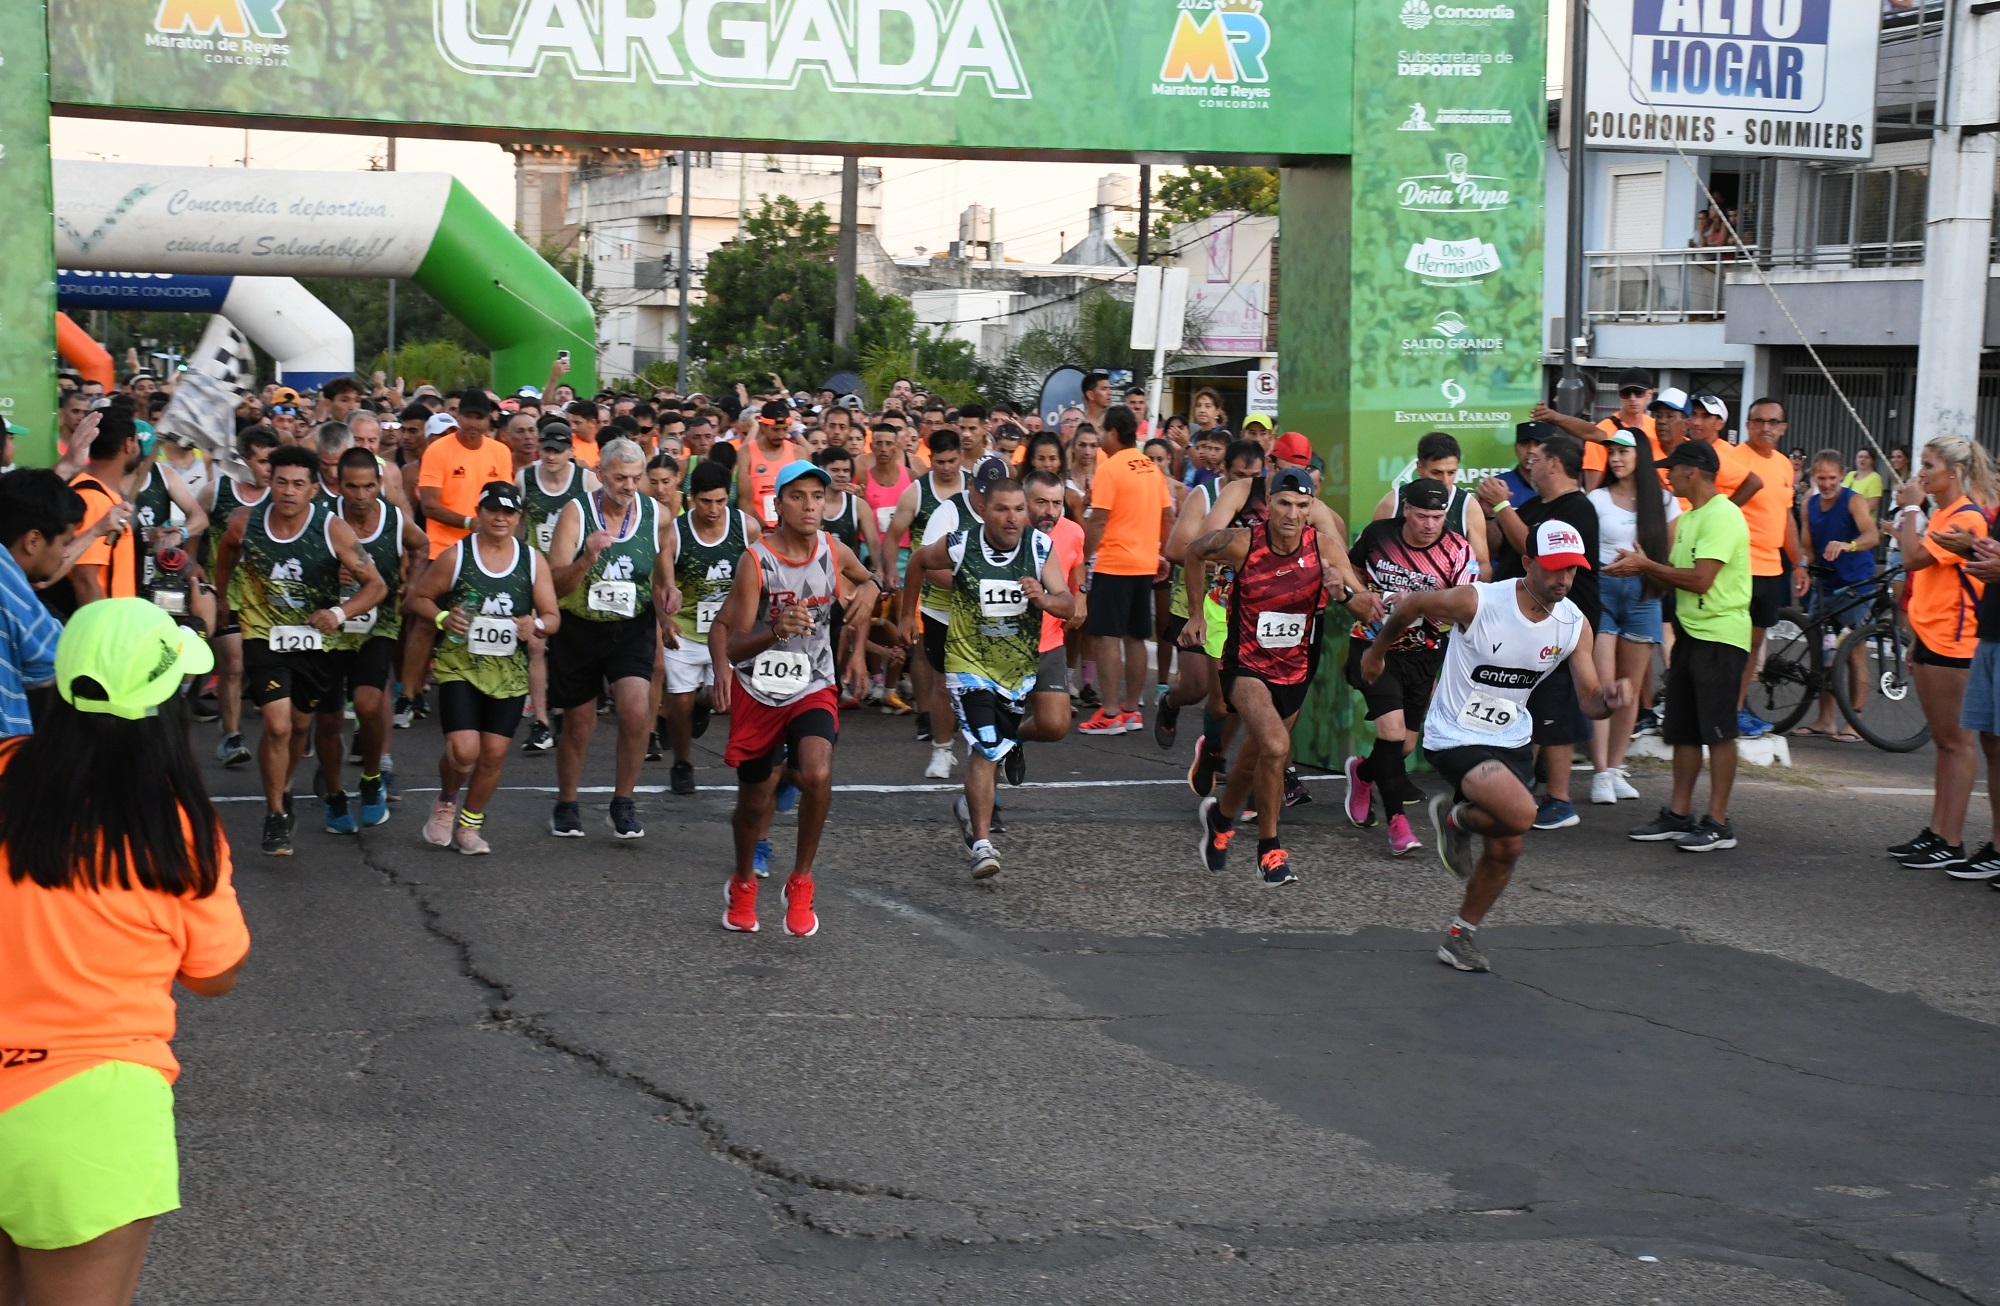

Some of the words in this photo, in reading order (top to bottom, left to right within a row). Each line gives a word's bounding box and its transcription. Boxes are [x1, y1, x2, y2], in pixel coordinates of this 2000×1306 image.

[1433, 4, 1515, 19] Concordia
[145, 33, 214, 50] Maraton
[217, 38, 239, 52] de
[242, 39, 290, 56] Reyes
[203, 54, 289, 67] CONCORDIA
[1397, 50, 1492, 63] Subsecretaria
[1494, 51, 1514, 64] de
[1397, 63, 1482, 76] DEPORTES
[1651, 39, 1804, 100] HOGAR
[1151, 83, 1208, 96] Maraton
[1210, 84, 1229, 97] de
[1230, 85, 1271, 100] Reyes
[1198, 99, 1270, 109] CONCORDIA
[1586, 111, 1715, 142] COLCHONES
[1745, 119, 1863, 150] SOMMIERS
[167, 189, 278, 216] Concordia
[1397, 181, 1454, 206] Doña
[1455, 181, 1510, 211] Pupa
[165, 235, 244, 254] ciudad
[1442, 244, 1465, 258] Dos
[1416, 253, 1490, 274] Hermanos
[121, 286, 139, 297] DE
[141, 286, 212, 298] CONCORDIA
[1401, 338, 1445, 350] SALTO
[1447, 338, 1503, 349] GRANDE
[1409, 571, 1428, 582] por
[1427, 573, 1437, 585] la
[985, 588, 1022, 605] 116
[473, 627, 512, 645] 106
[1261, 621, 1300, 637] 118
[275, 635, 315, 652] 120
[759, 660, 803, 680] 104
[1466, 702, 1511, 726] 119
[0, 1048, 48, 1068] 25
